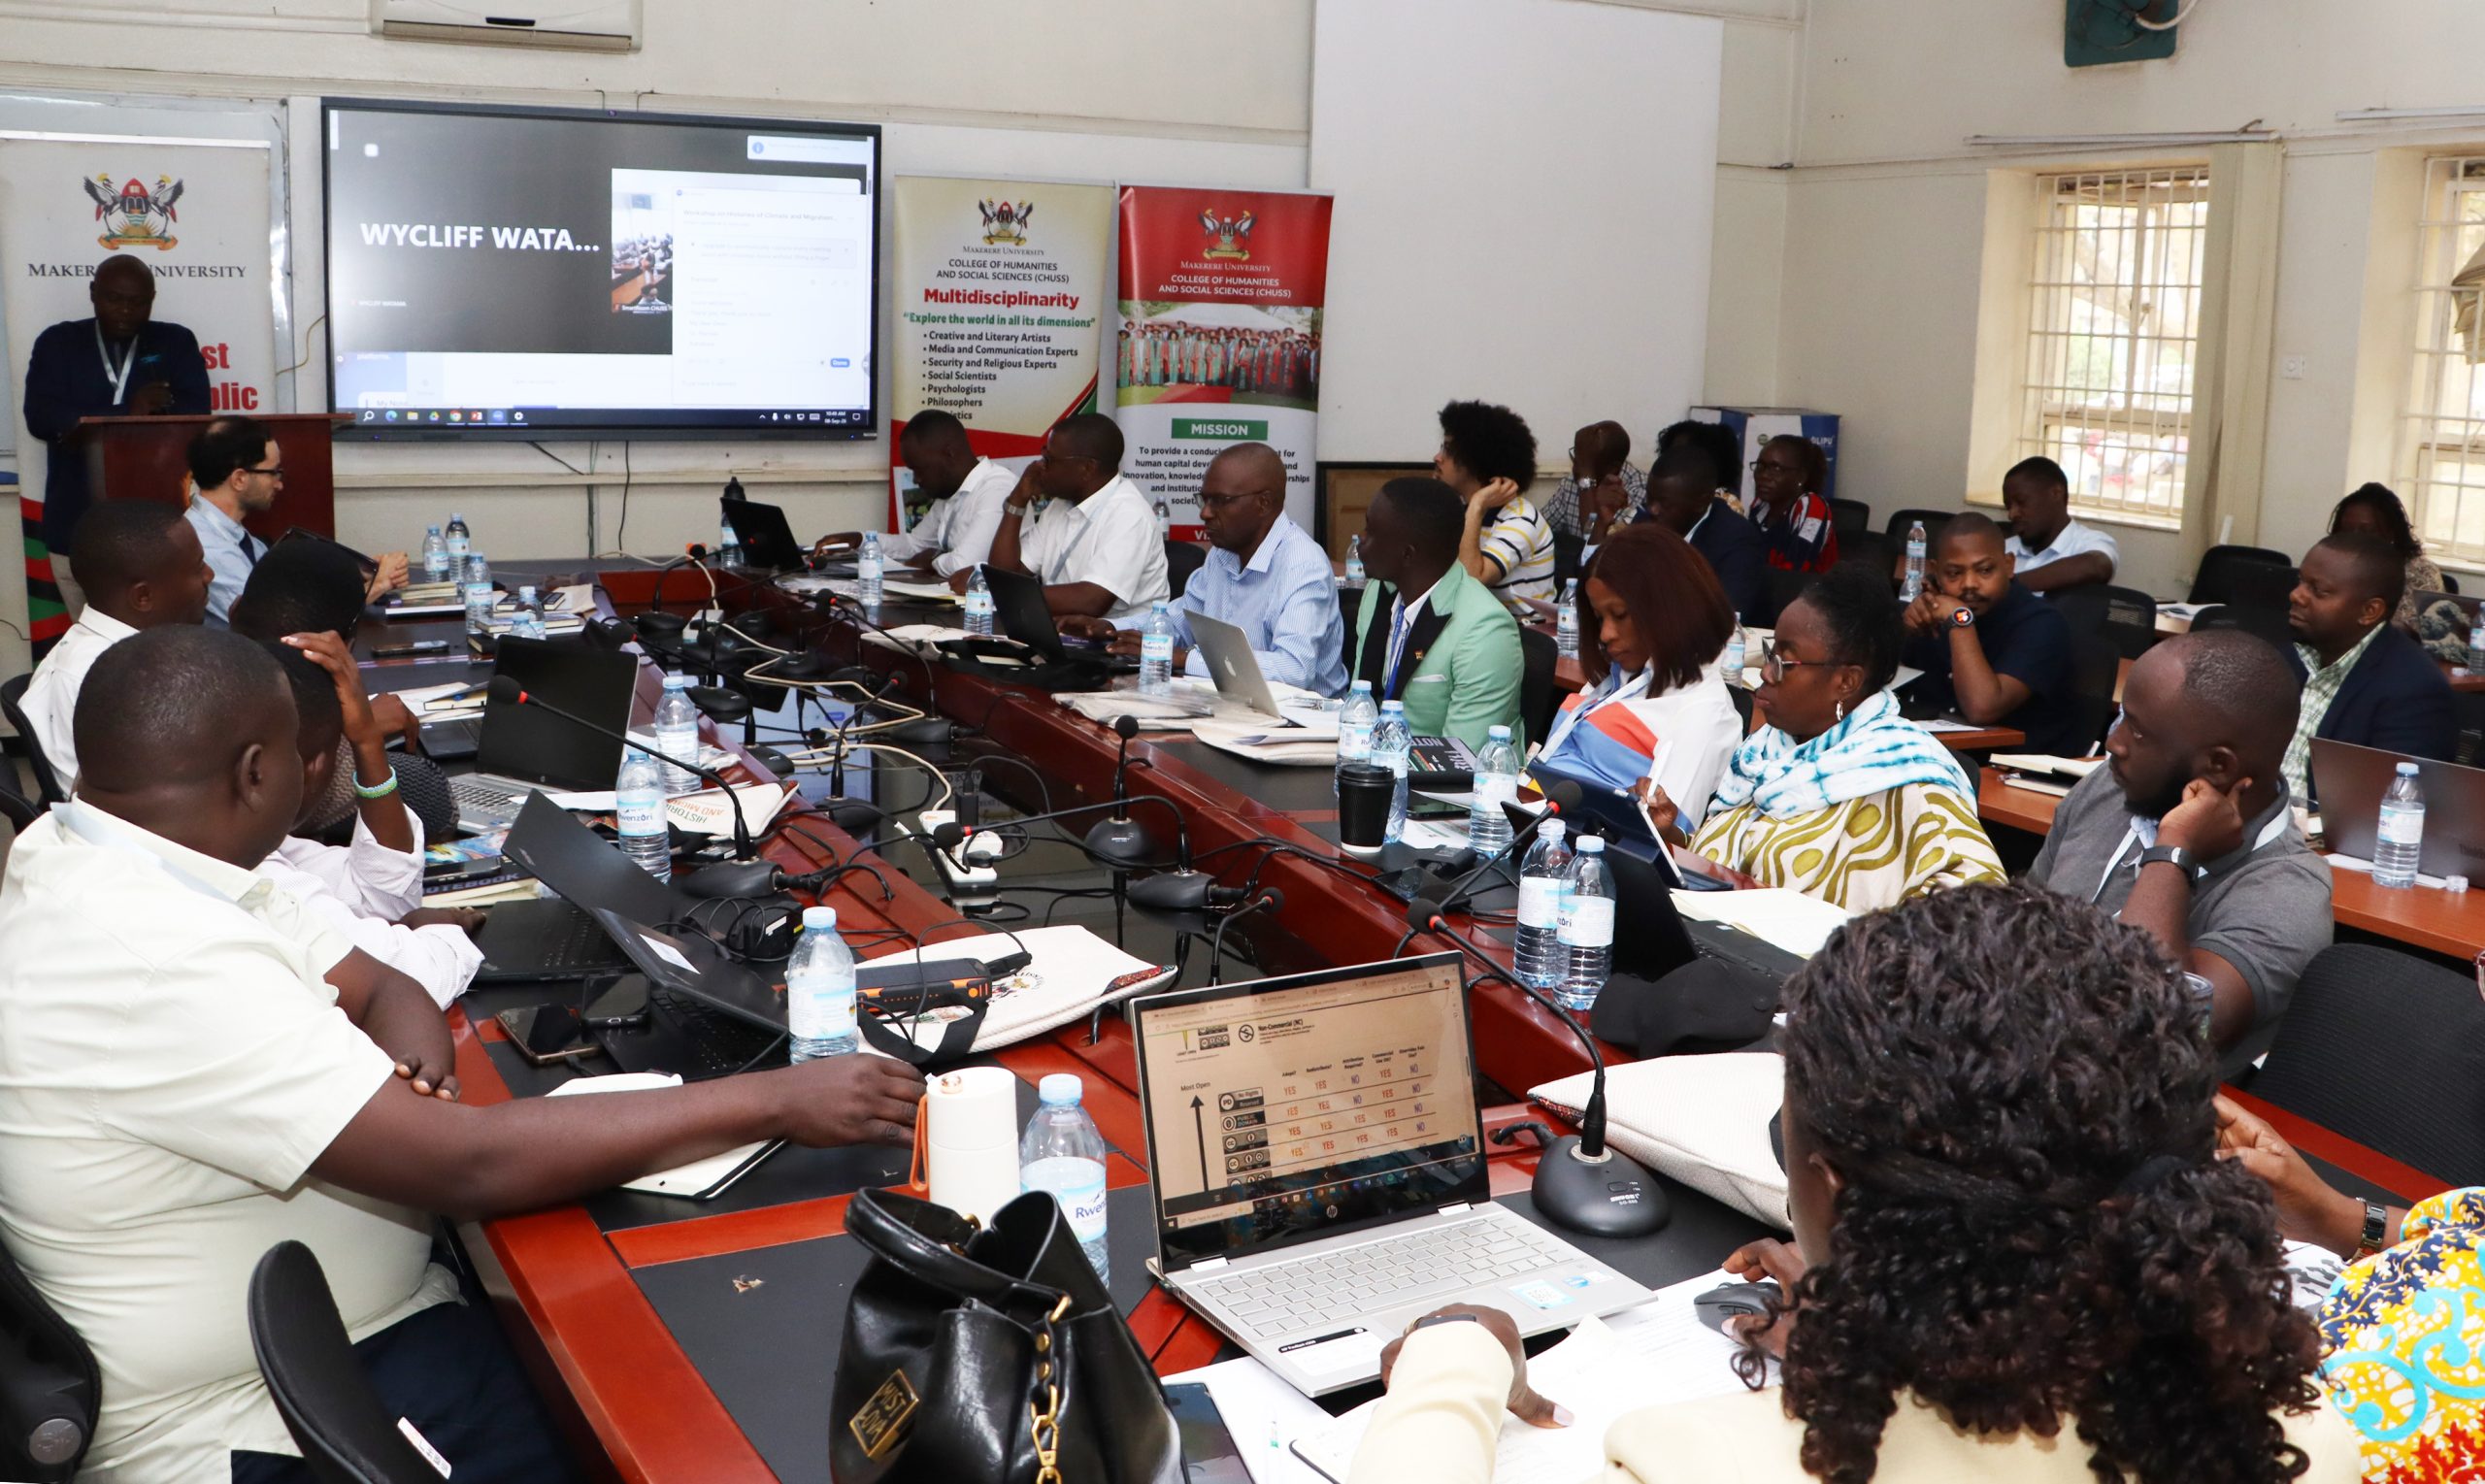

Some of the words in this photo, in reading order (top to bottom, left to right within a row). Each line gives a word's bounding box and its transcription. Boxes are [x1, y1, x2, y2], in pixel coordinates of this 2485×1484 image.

[360, 223, 483, 247] WYCLIFF
[491, 226, 600, 251] WATA...
[28, 263, 96, 278] MAKER
[949, 259, 988, 268] COLLEGE
[1003, 261, 1058, 271] HUMANITIES
[1180, 260, 1223, 270] MAKERERE
[1224, 262, 1271, 272] UNIVERSITY
[936, 270, 956, 279] AND
[958, 271, 989, 280] SOCIAL
[992, 272, 1032, 281] SCIENCES
[1034, 274, 1069, 283] (CHUSS)
[1171, 274, 1209, 283] COLLEGE
[1225, 277, 1279, 286] HUMANITIES
[1180, 286, 1211, 294] SOCIAL
[1214, 287, 1254, 296] SCIENCES
[1256, 288, 1291, 298] (CHUSS)
[924, 289, 1079, 310] Multidisciplinarity
[948, 313, 965, 324] the
[970, 314, 995, 325] world
[997, 315, 1006, 325] in
[1008, 315, 1020, 325] all
[1022, 316, 1035, 326] its
[929, 330, 965, 340] Creative
[967, 331, 983, 341] and
[985, 332, 1019, 343] Literary
[1021, 333, 1051, 342] Artists
[201, 343, 230, 369] st
[929, 344, 955, 353] Media
[957, 345, 973, 354] and
[975, 345, 1044, 355] Communication
[1046, 347, 1078, 357] Experts
[928, 357, 963, 368] Security
[966, 358, 982, 367] and
[984, 359, 1022, 369] Religious
[1024, 360, 1057, 370] Experts
[928, 371, 953, 380] Social
[955, 371, 997, 380] Scientists
[927, 384, 986, 395] Psychologists
[927, 397, 983, 408] Philosophers
[1191, 424, 1249, 436] MISSION
[1139, 446, 1149, 455] To
[1151, 447, 1181, 456] provide
[1164, 460, 1190, 468] capital
[426, 874, 519, 893] OTEBOOK
[1284, 1086, 1296, 1095] YES
[1315, 1080, 1327, 1090] YES
[1351, 1075, 1359, 1084] NO
[1380, 1069, 1392, 1078] YES
[1410, 1064, 1418, 1073] NO
[1287, 1106, 1298, 1116] YES
[1318, 1101, 1330, 1110] YES
[1353, 1095, 1362, 1105] NO
[1382, 1089, 1393, 1098] YES
[1412, 1084, 1420, 1094] NO
[1289, 1126, 1301, 1136] YES
[1320, 1121, 1332, 1131] YES
[1354, 1114, 1366, 1123] YES
[1384, 1109, 1396, 1118] YES
[1414, 1103, 1422, 1113] NO
[1291, 1148, 1303, 1157] YES
[1322, 1141, 1334, 1150] YES
[1356, 1134, 1368, 1143] YES
[1386, 1128, 1398, 1137] YES
[1416, 1122, 1425, 1132] NO
